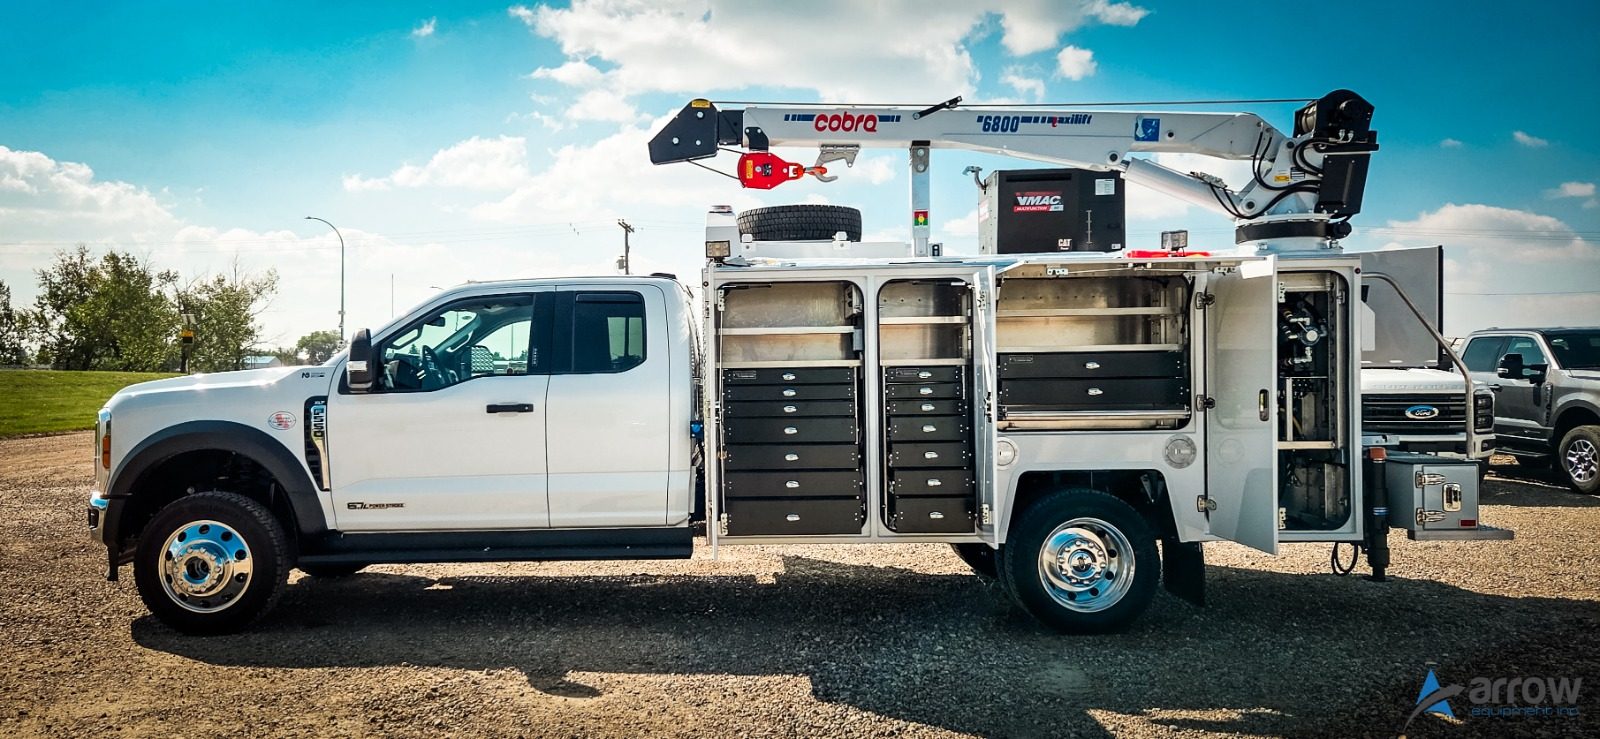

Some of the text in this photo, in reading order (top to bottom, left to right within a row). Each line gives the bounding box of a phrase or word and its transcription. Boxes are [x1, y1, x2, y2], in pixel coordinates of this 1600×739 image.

[814, 111, 877, 132] cobra
[982, 115, 1020, 132] 6800
[1017, 196, 1061, 205] VMAC
